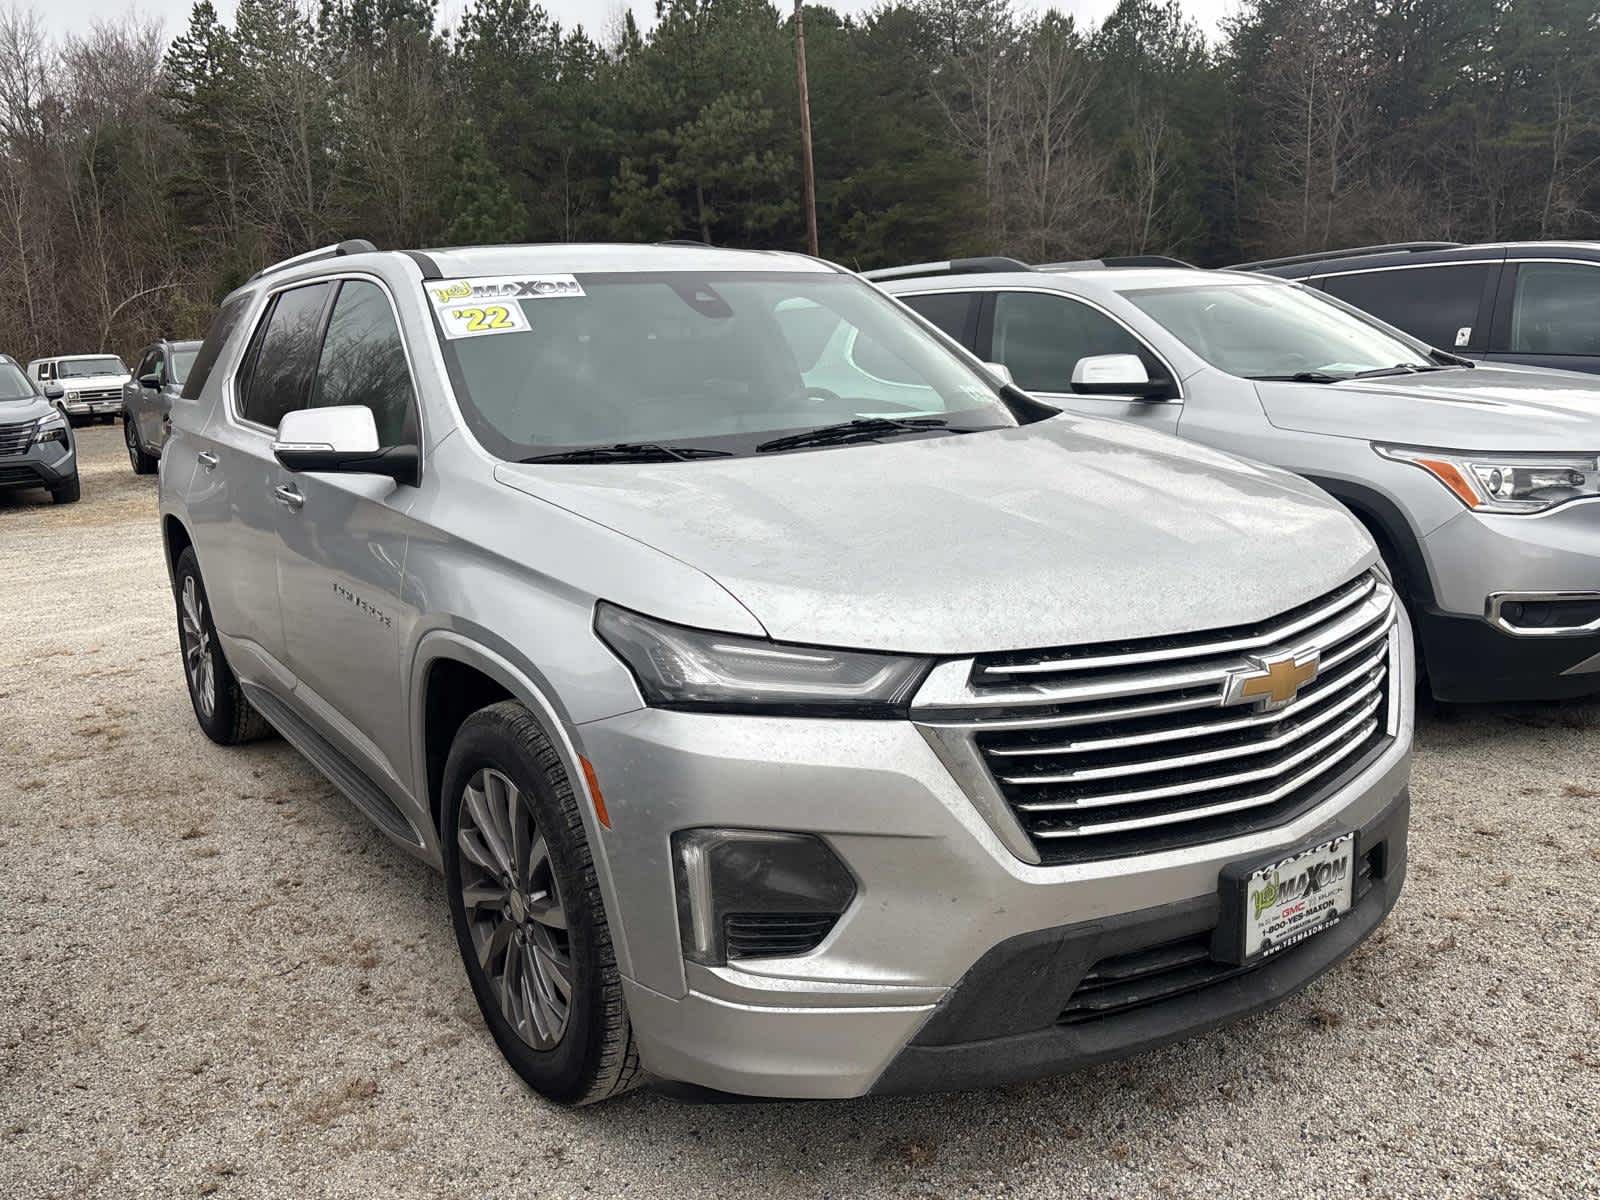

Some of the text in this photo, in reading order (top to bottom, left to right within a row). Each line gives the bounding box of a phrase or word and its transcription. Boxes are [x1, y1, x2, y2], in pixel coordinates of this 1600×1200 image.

[1276, 856, 1347, 907] MAXON
[1262, 899, 1335, 936] 1-800-YES-MAXON
[1281, 901, 1306, 918] GMC
